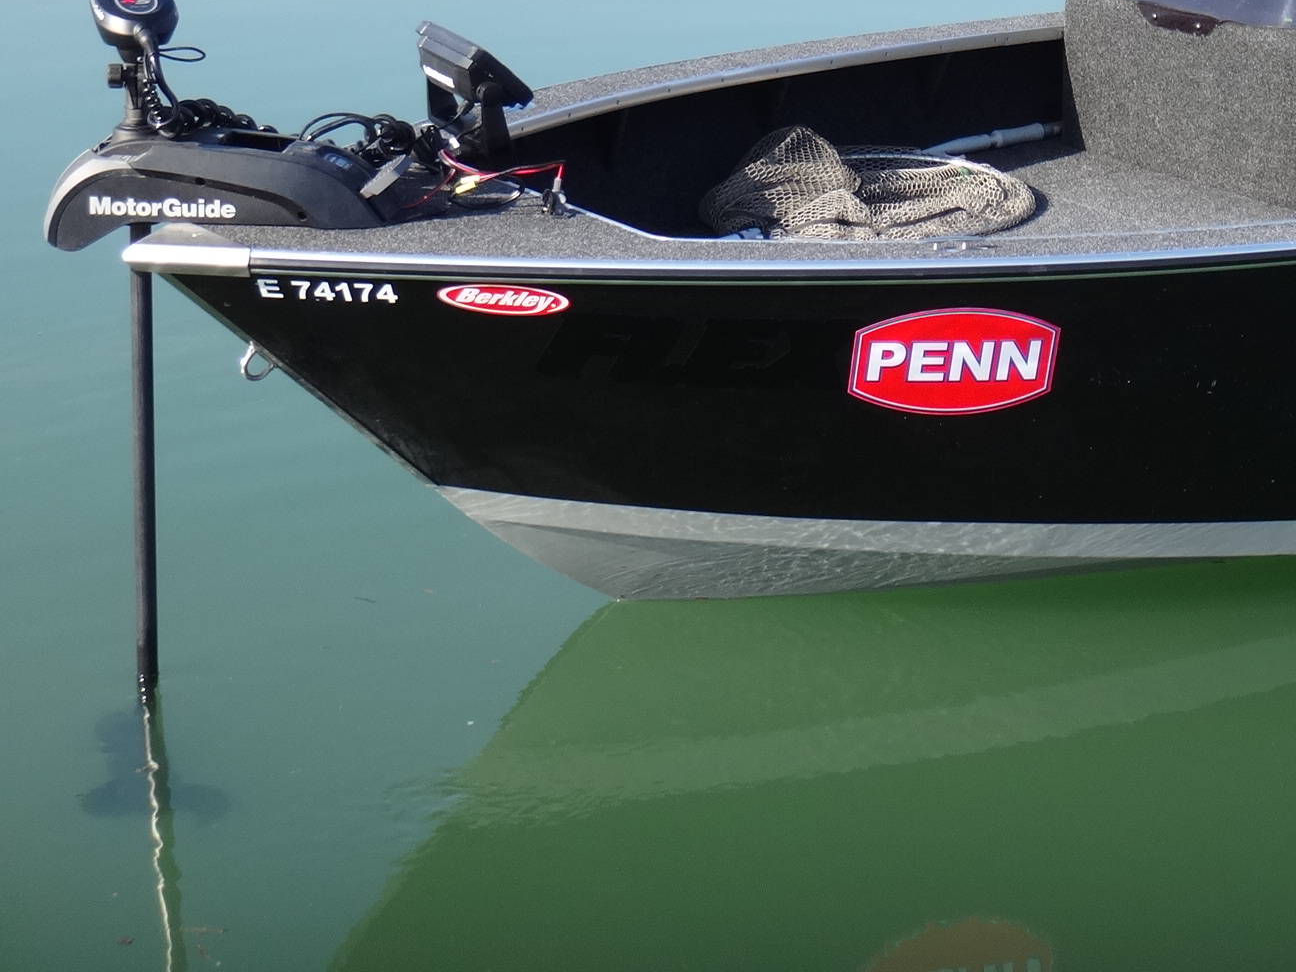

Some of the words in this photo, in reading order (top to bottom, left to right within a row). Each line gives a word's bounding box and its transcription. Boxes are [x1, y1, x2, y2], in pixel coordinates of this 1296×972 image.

[88, 196, 236, 219] MotorGuide
[256, 279, 285, 300] E
[291, 280, 399, 305] 74174
[455, 287, 556, 312] Berkley
[865, 339, 1043, 383] PENN
